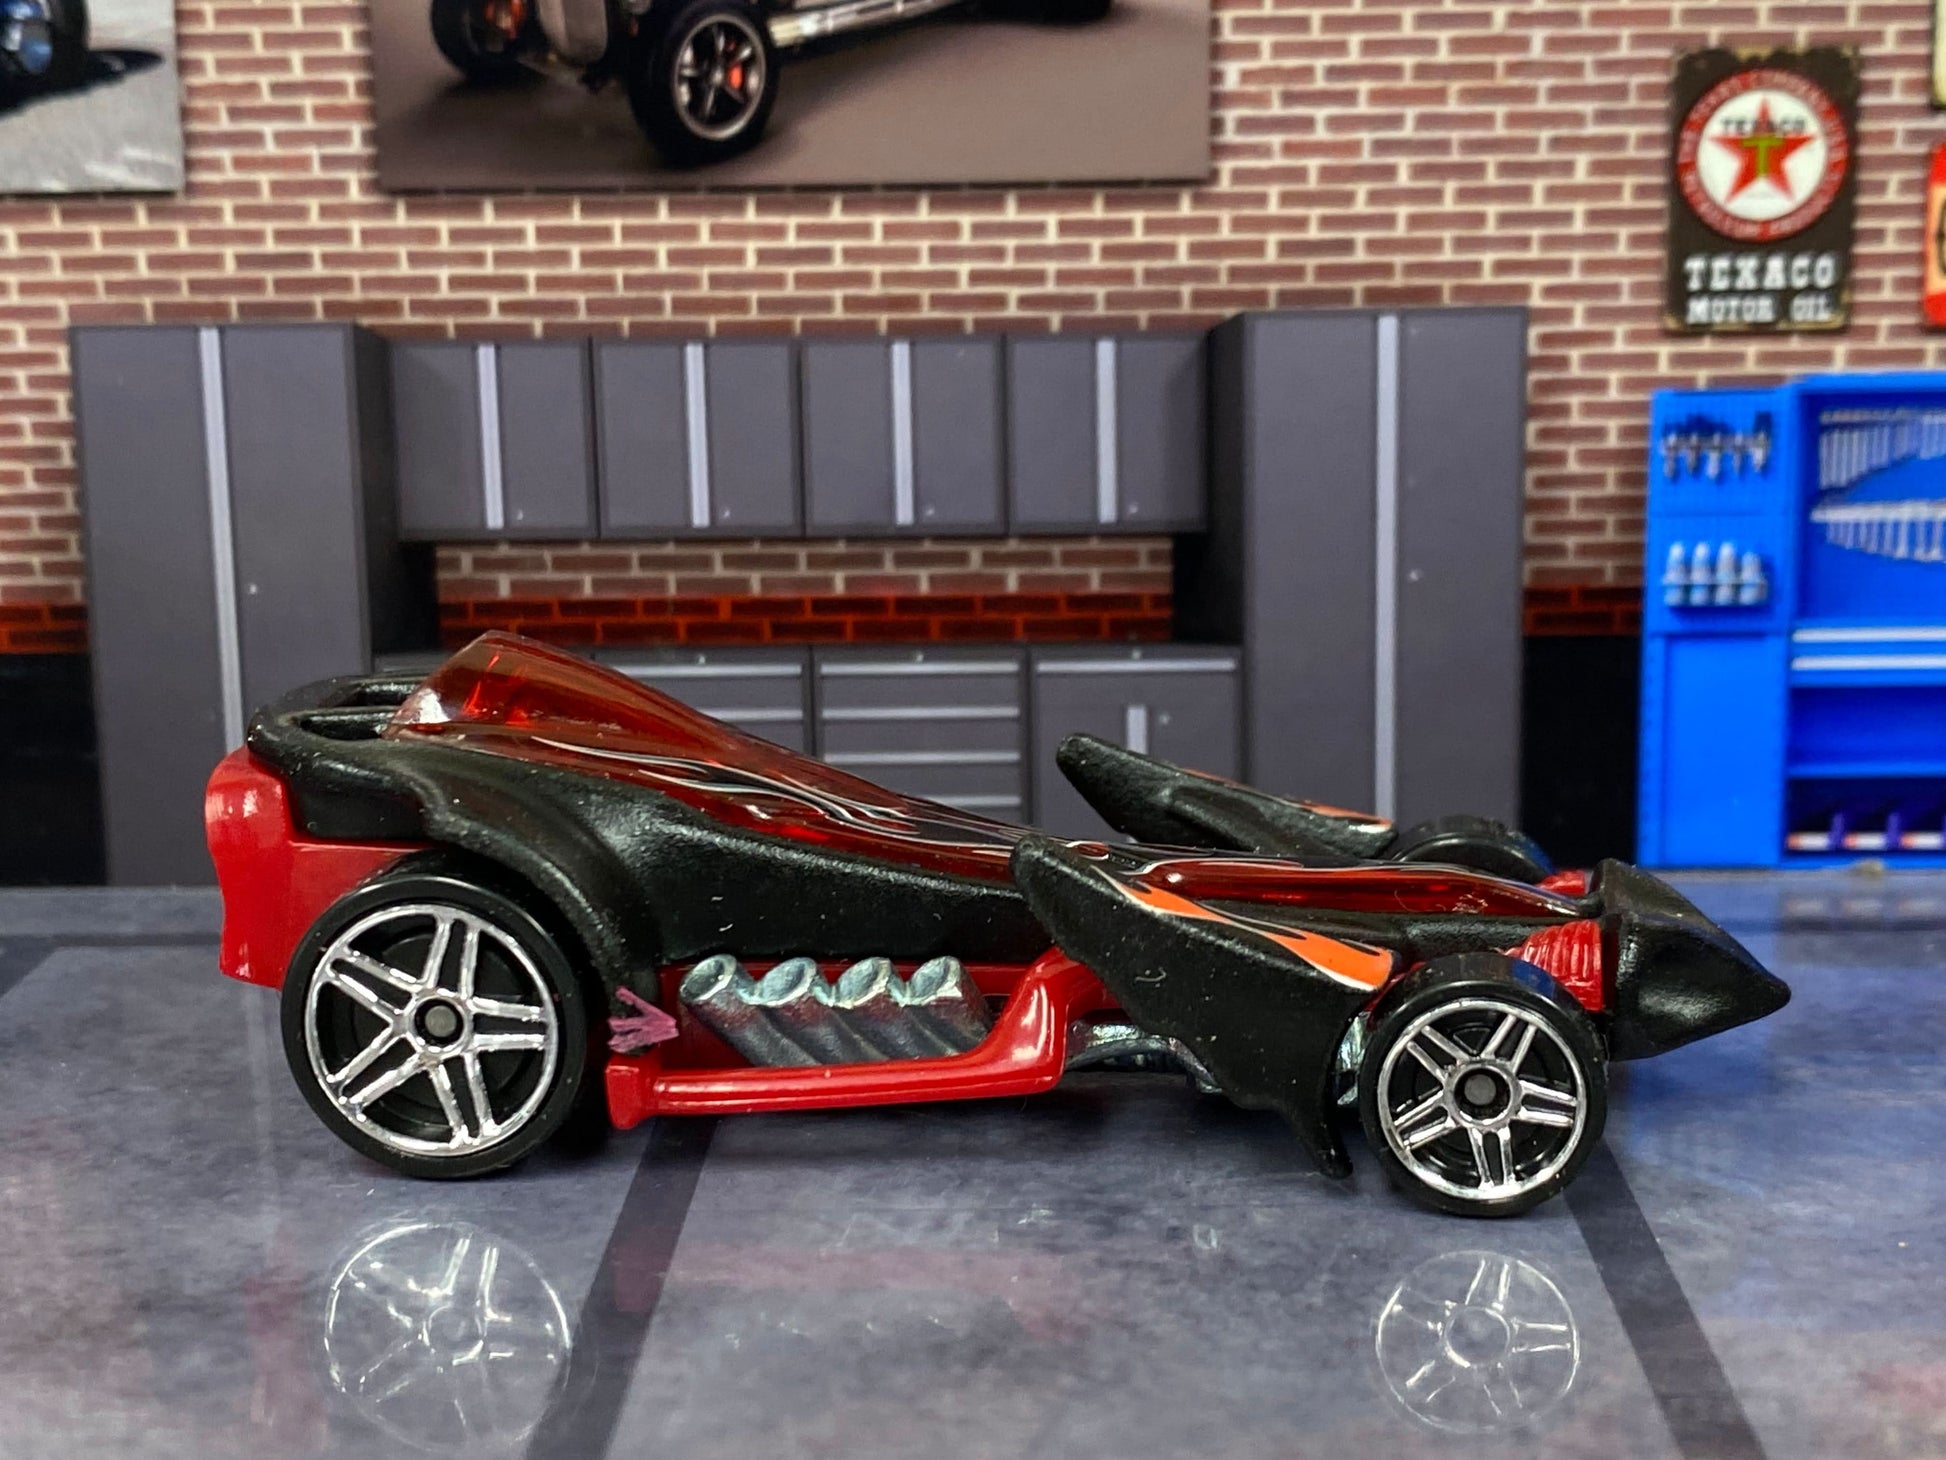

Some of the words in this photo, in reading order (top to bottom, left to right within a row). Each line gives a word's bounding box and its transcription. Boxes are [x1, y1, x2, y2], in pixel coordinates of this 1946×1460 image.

[1742, 133, 1785, 178] T
[1684, 253, 1836, 291] TEXACO
[1686, 294, 1776, 324] MOTOR
[1790, 292, 1831, 322] OIL
